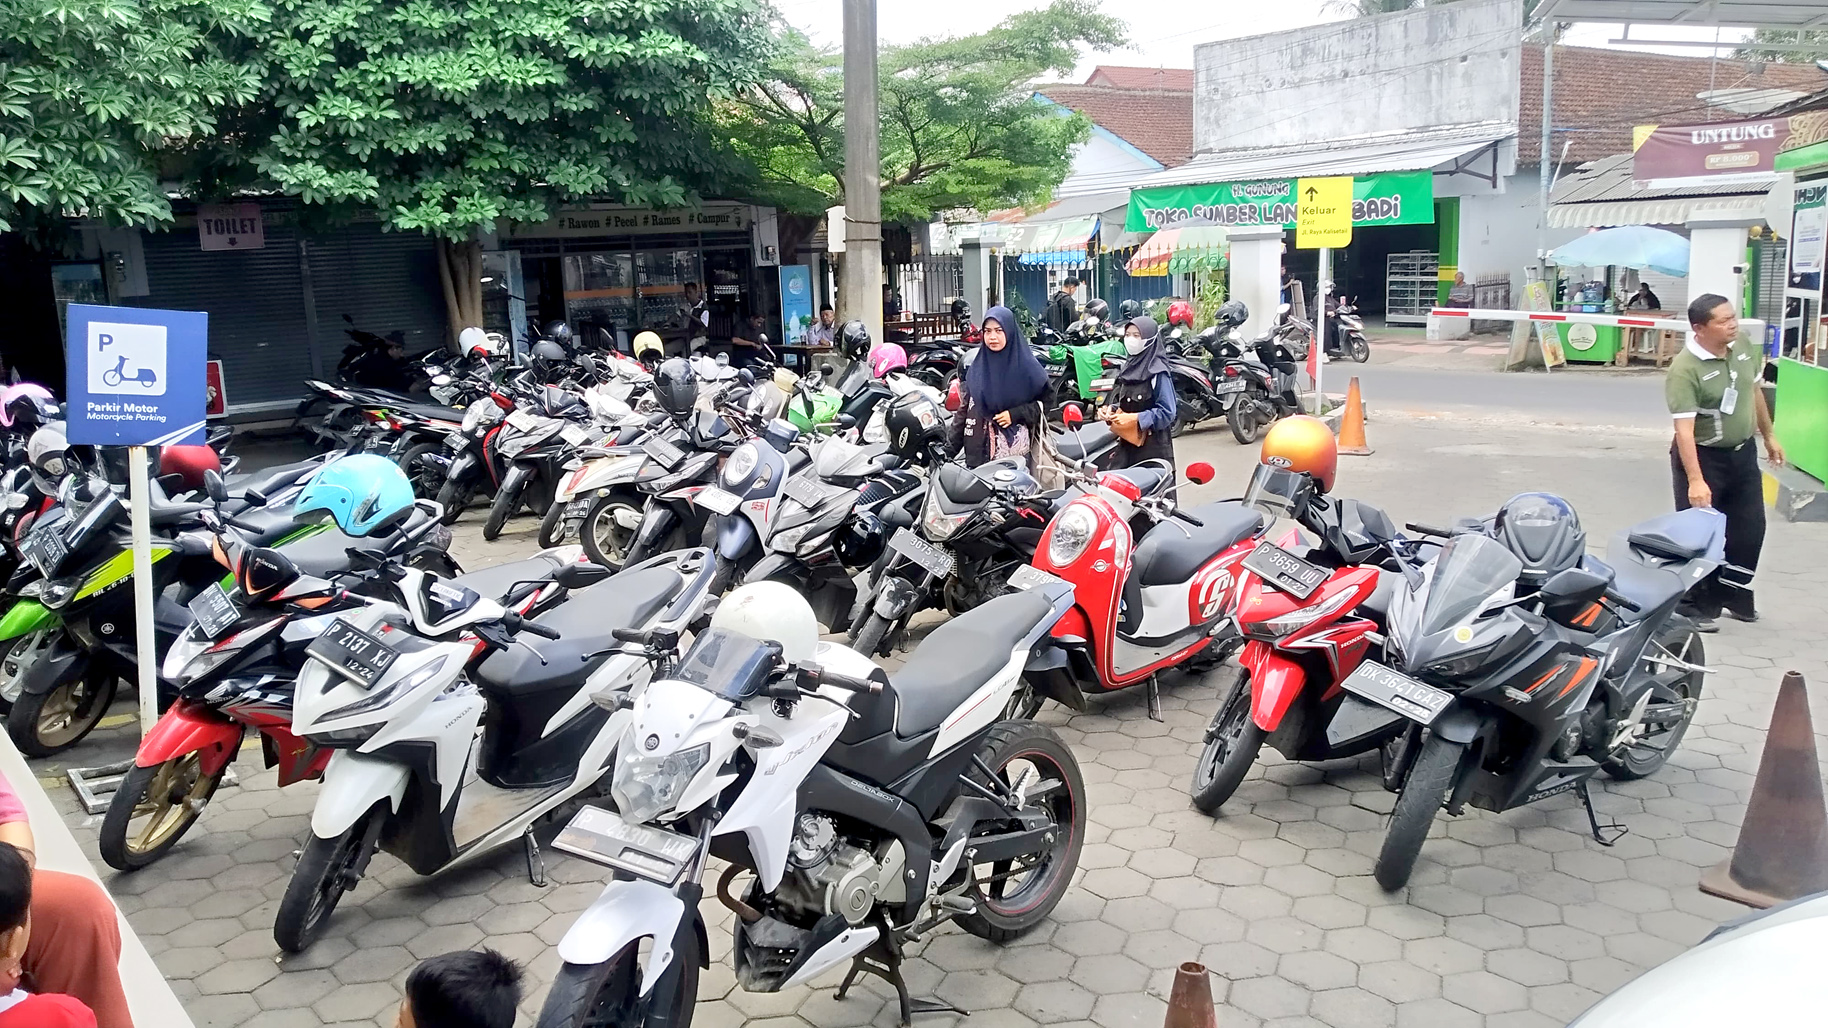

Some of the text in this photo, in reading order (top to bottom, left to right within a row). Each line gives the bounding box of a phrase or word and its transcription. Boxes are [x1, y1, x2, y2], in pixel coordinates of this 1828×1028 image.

[1691, 123, 1775, 145] UNTUNG
[1245, 181, 1289, 197] GUNUNG
[568, 216, 600, 230] Rawon
[614, 215, 638, 228] Pecel
[651, 214, 681, 226] Rames
[697, 212, 731, 226] Campur
[1143, 207, 1189, 229] TOKO
[1192, 203, 1259, 224] SUMBER
[1302, 206, 1337, 216] Keluar
[203, 217, 257, 235] TOILET
[99, 334, 113, 352] P
[87, 402, 158, 413] Parkir Motor
[87, 412, 167, 423] Motorcycle Parking
[896, 529, 905, 538] P
[1258, 546, 1319, 584] P 3659 UU
[210, 591, 230, 614] 5507
[327, 624, 341, 638] P
[338, 631, 371, 655] 2137
[370, 649, 392, 669] XJ
[1360, 664, 1381, 681] DK
[1379, 674, 1416, 696] 3641
[445, 706, 473, 729] HONDA
[850, 780, 895, 802] DELTABOX
[1525, 782, 1577, 803] HONDA
[661, 837, 692, 861] WK
